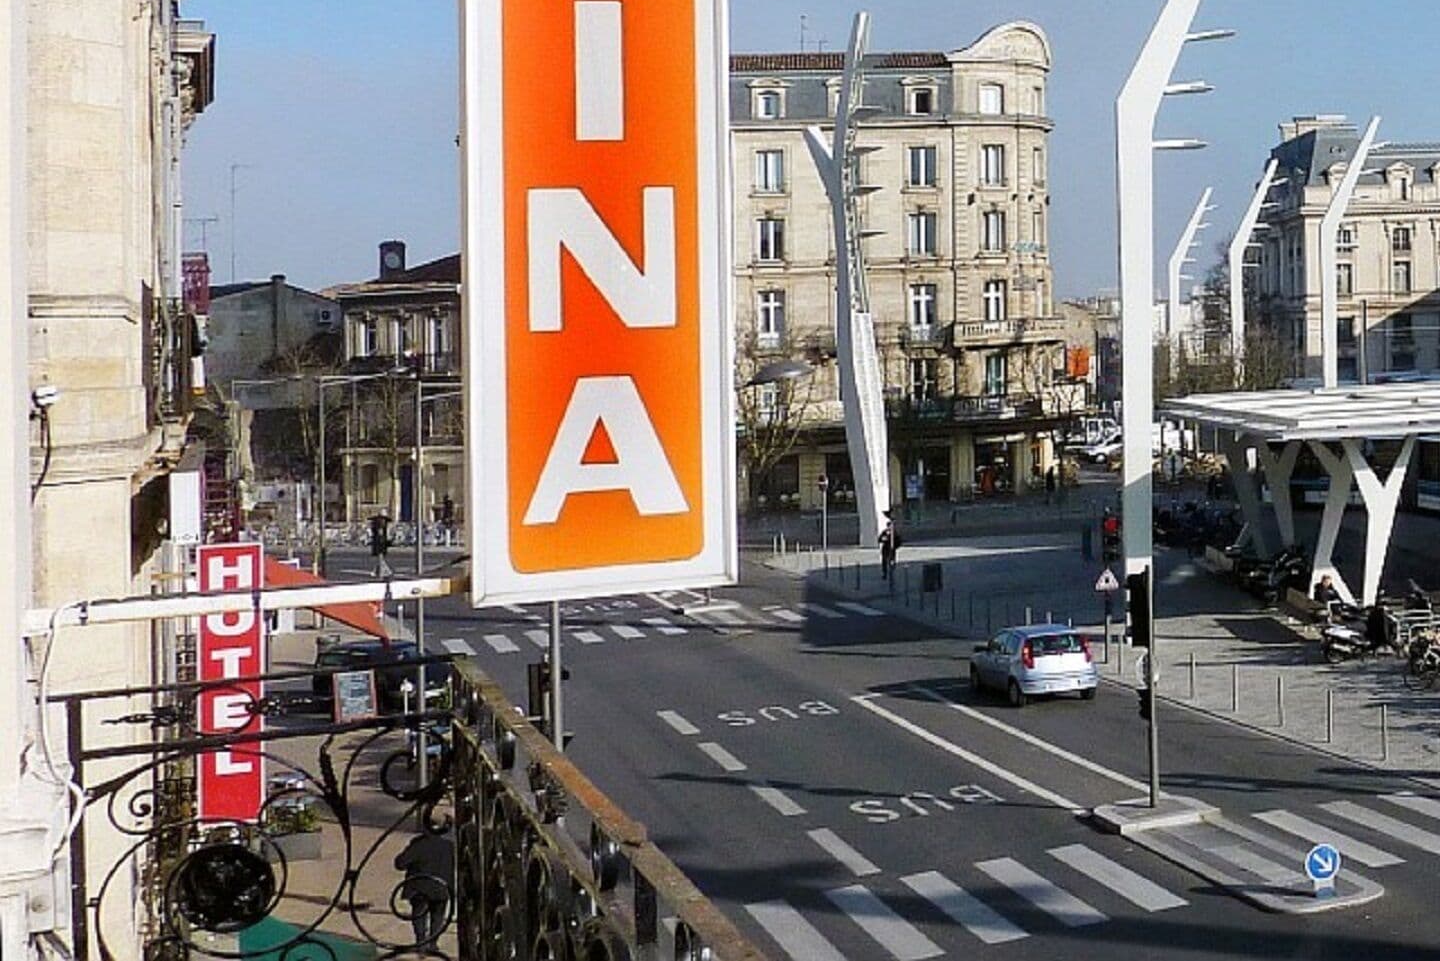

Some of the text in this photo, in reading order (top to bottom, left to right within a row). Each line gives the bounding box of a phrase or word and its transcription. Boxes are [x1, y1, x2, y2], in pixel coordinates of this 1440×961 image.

[206, 553, 255, 776] HOTEL
[717, 700, 841, 727] BUS
[849, 783, 1006, 823] BUS
